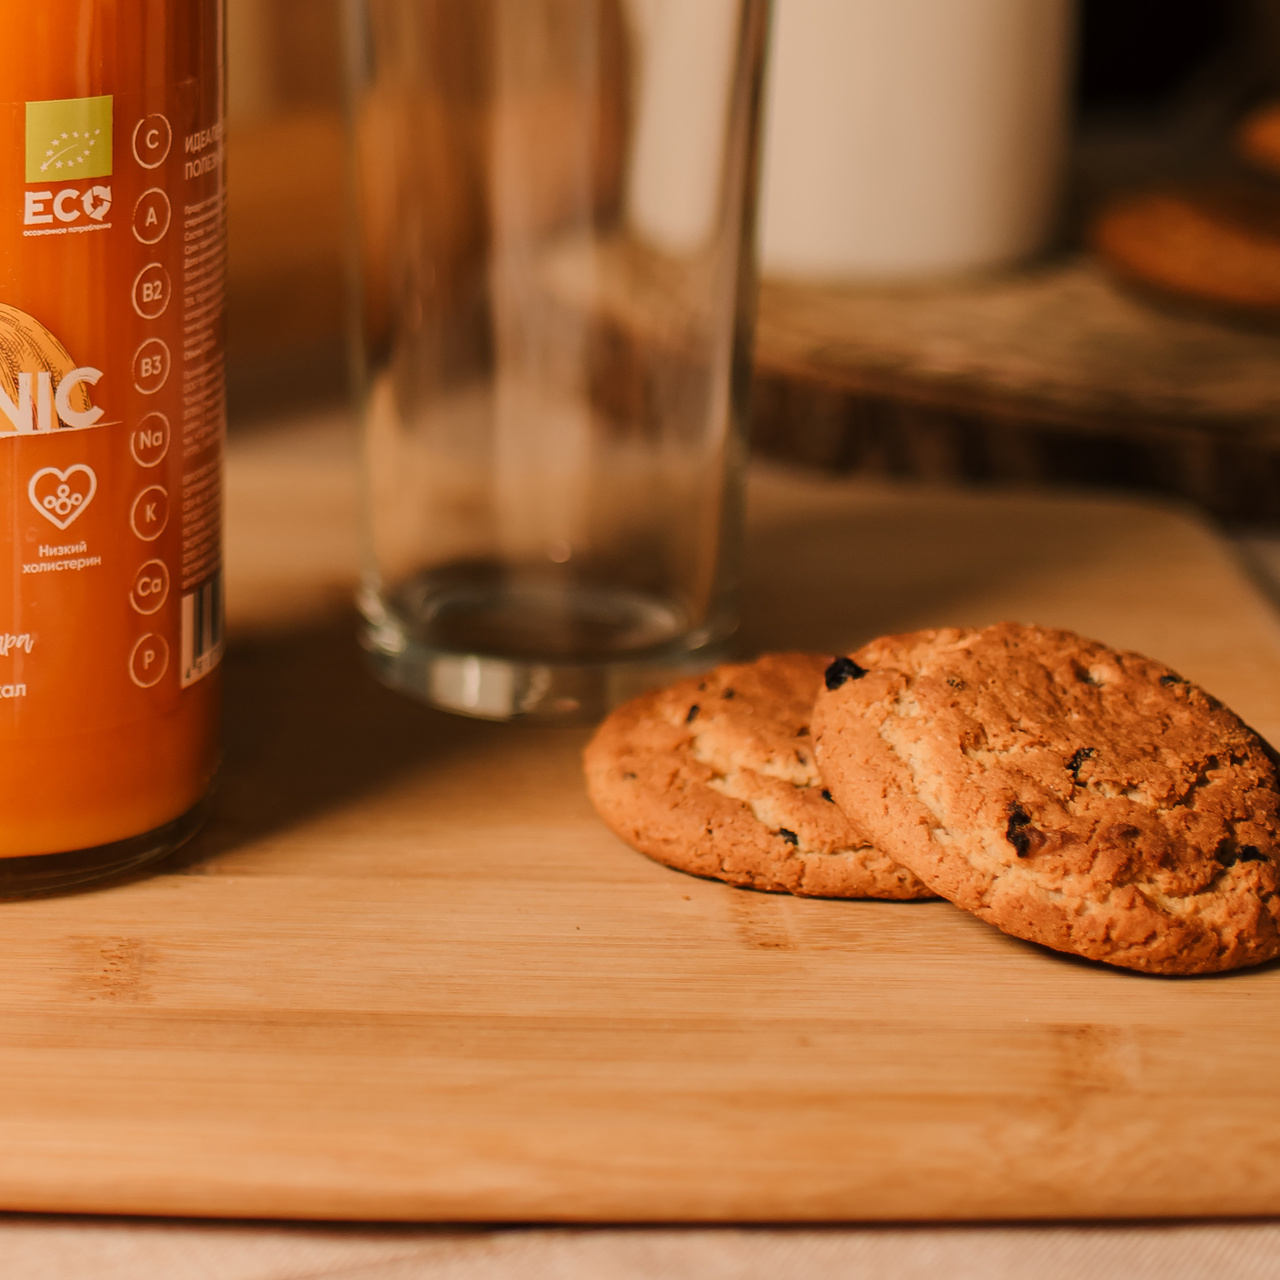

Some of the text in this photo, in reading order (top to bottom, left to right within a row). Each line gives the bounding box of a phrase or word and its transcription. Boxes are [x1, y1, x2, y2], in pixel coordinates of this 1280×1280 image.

[145, 129, 159, 149] C
[23, 185, 112, 225] ECO
[146, 207, 158, 227] A
[142, 281, 163, 303] B2
[141, 356, 162, 378] B3
[138, 429, 163, 449] Na
[145, 502, 156, 522] K
[38, 541, 88, 558] Низкий
[22, 555, 102, 574] холистерин
[137, 575, 162, 597] Ca
[143, 649, 155, 669] P
